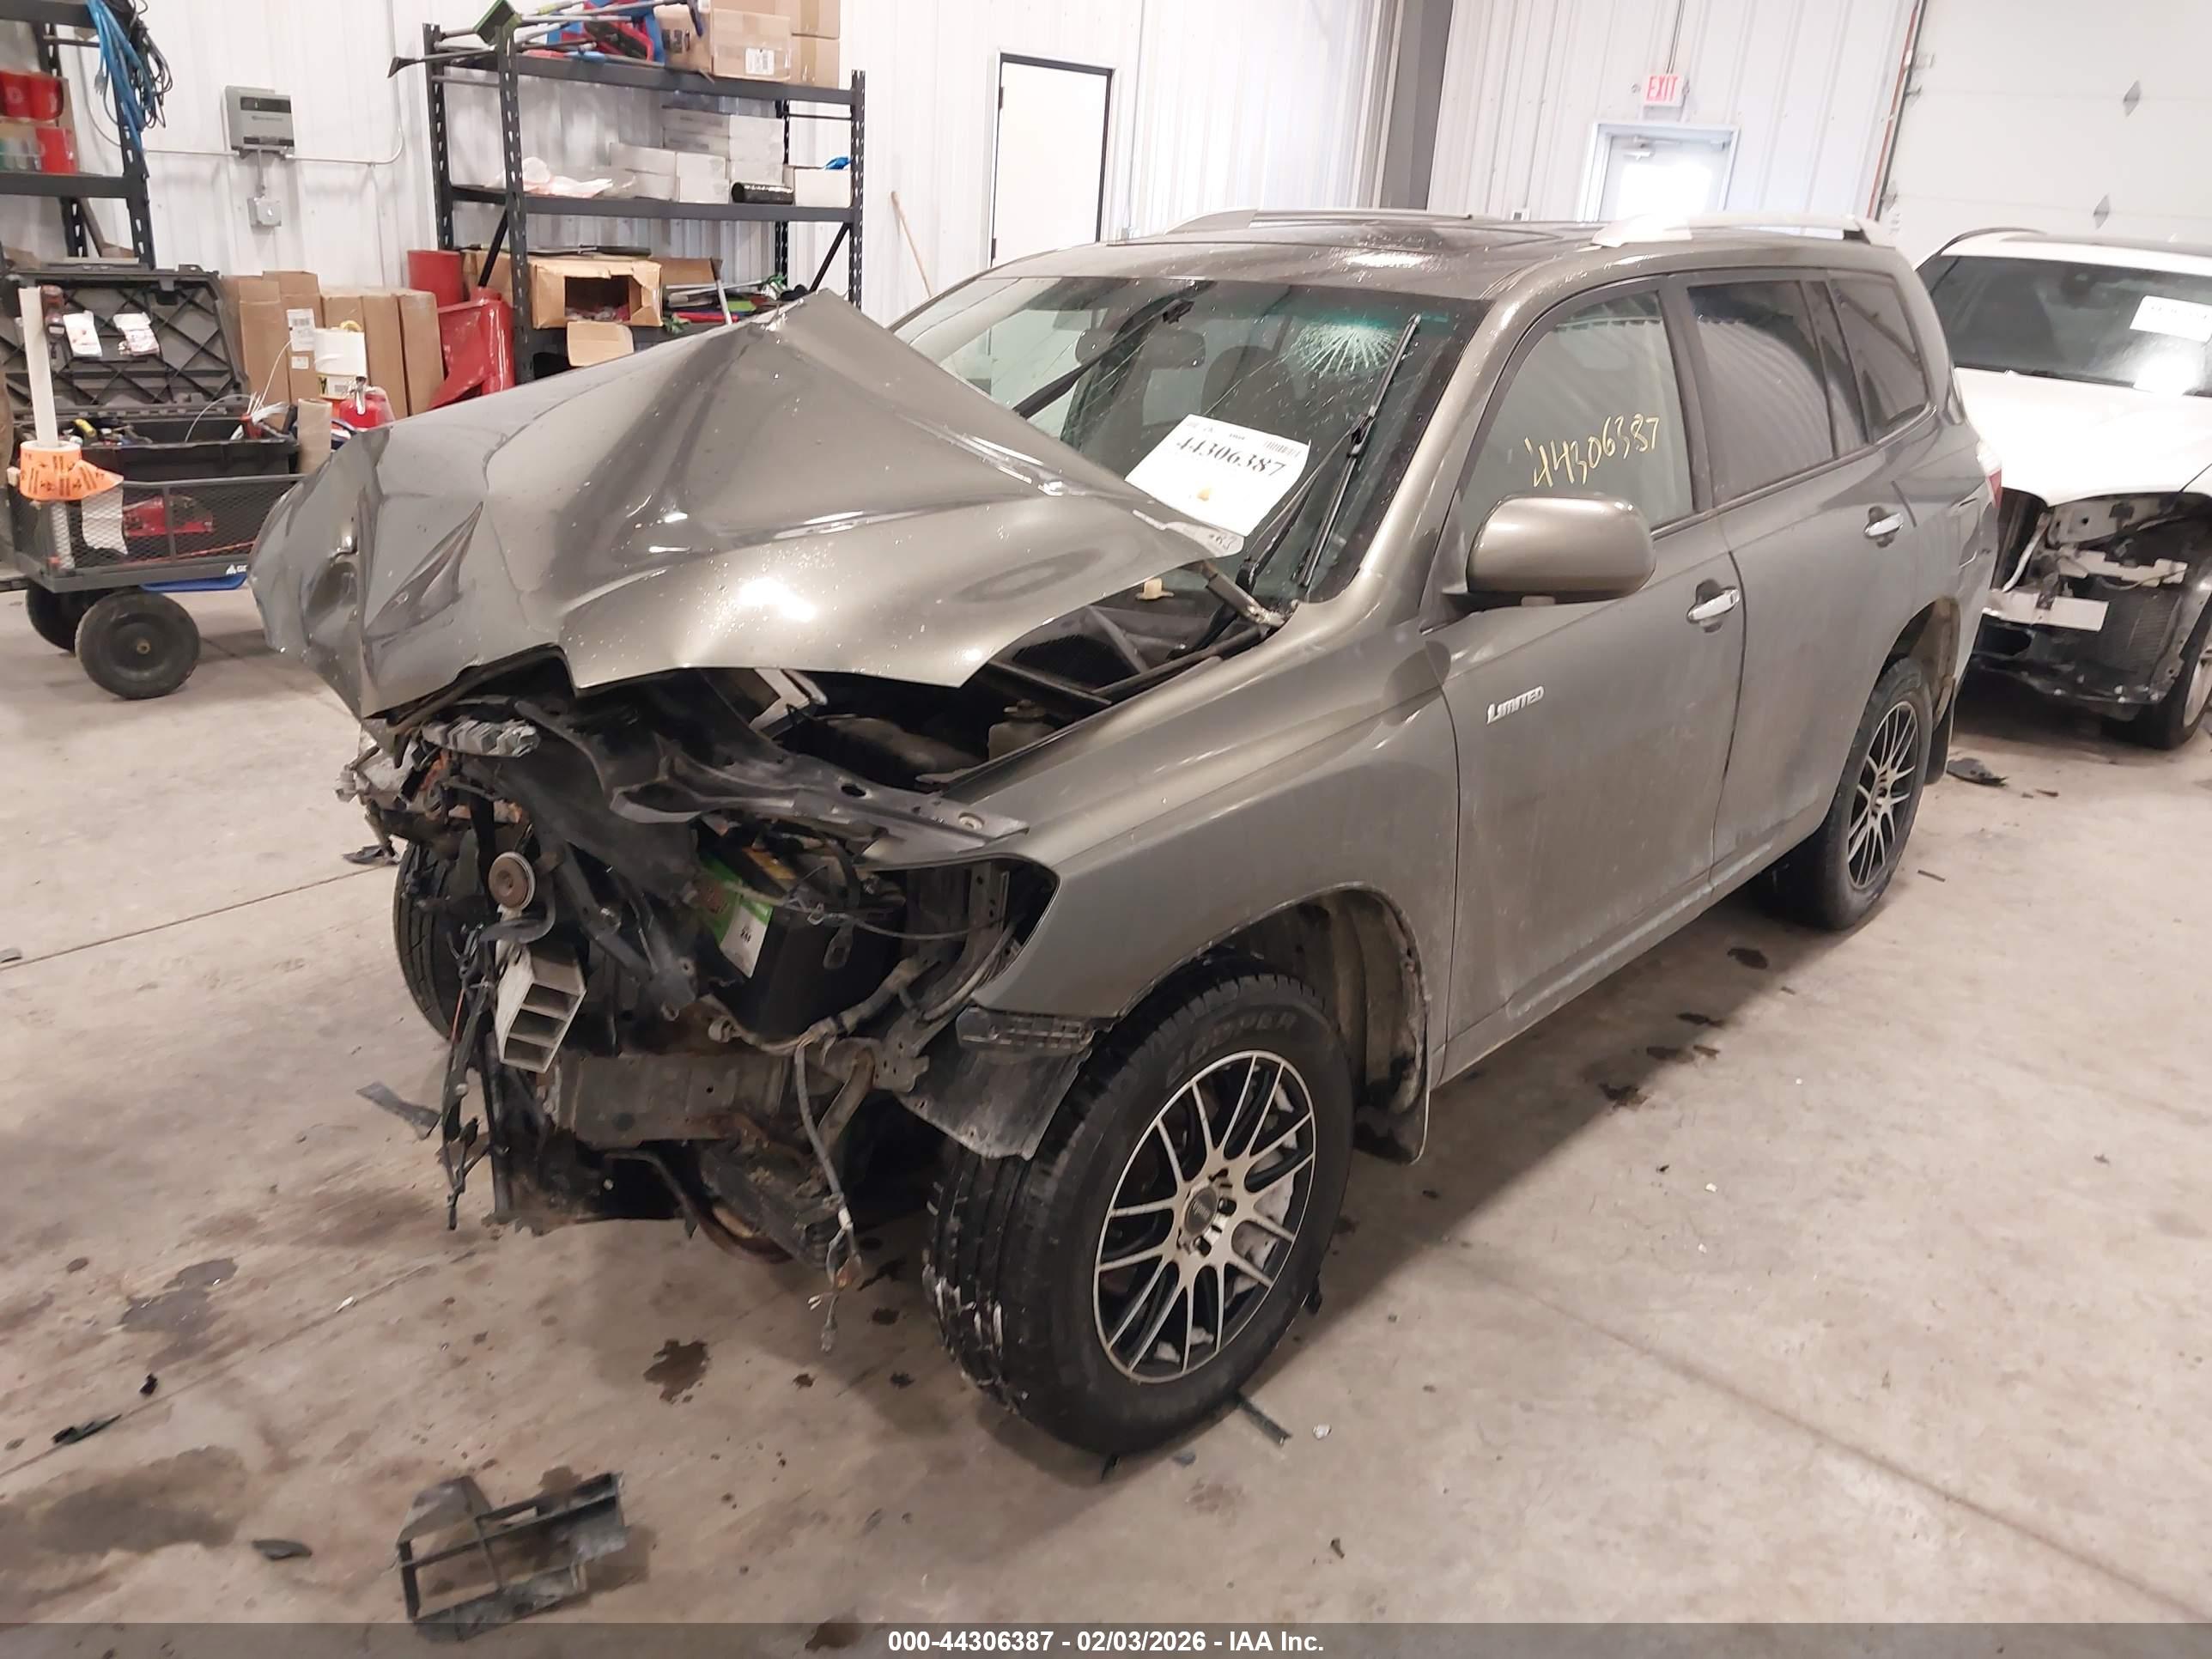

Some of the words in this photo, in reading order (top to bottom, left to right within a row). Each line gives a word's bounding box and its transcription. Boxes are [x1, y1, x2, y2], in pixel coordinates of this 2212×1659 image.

[1646, 75, 1678, 101] EXIT
[1176, 436, 1287, 477] 44306387
[1525, 413, 1660, 488] 44306387
